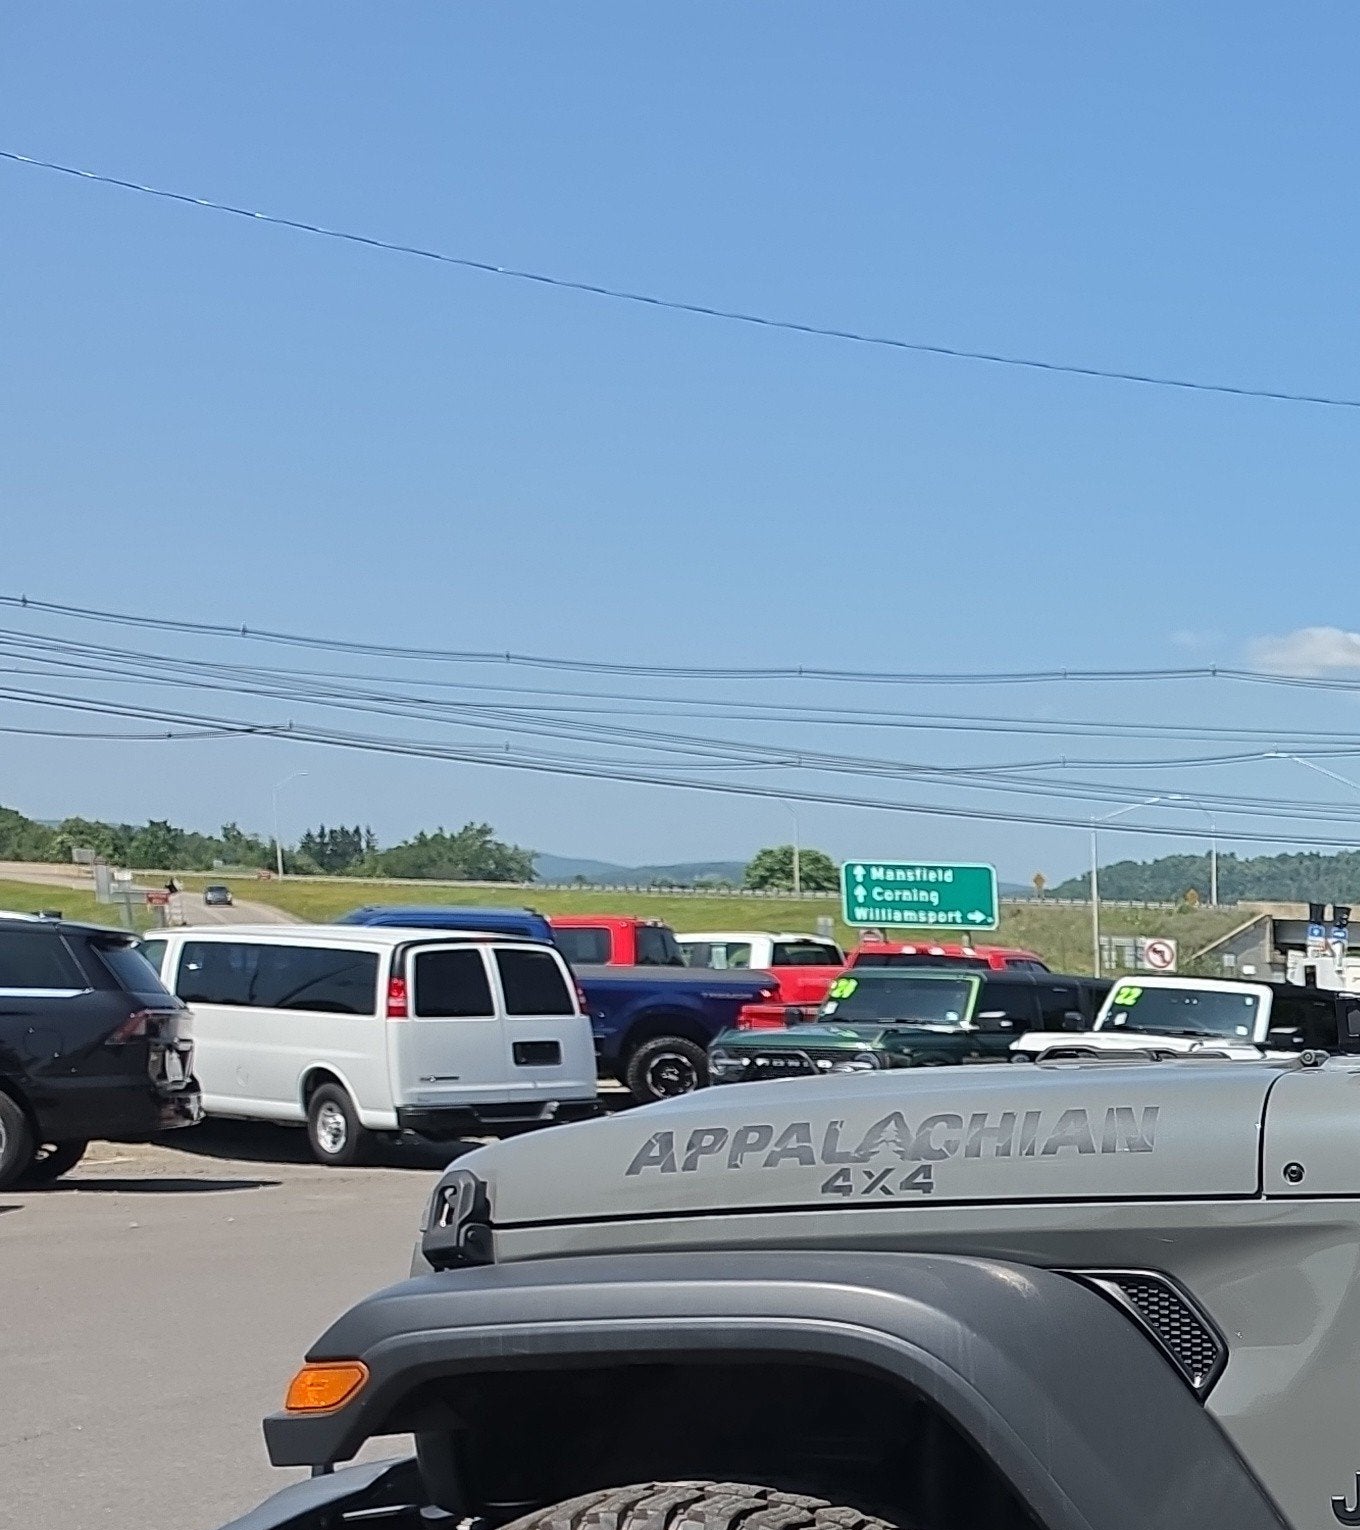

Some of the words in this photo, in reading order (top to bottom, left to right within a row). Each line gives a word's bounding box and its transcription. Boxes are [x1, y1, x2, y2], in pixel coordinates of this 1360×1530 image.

[869, 866, 953, 883] Mansfield
[871, 886, 939, 906] Corning
[854, 907, 963, 924] Williamsport
[1114, 986, 1143, 1006] 22
[625, 1106, 1161, 1176] APPALACHIAN
